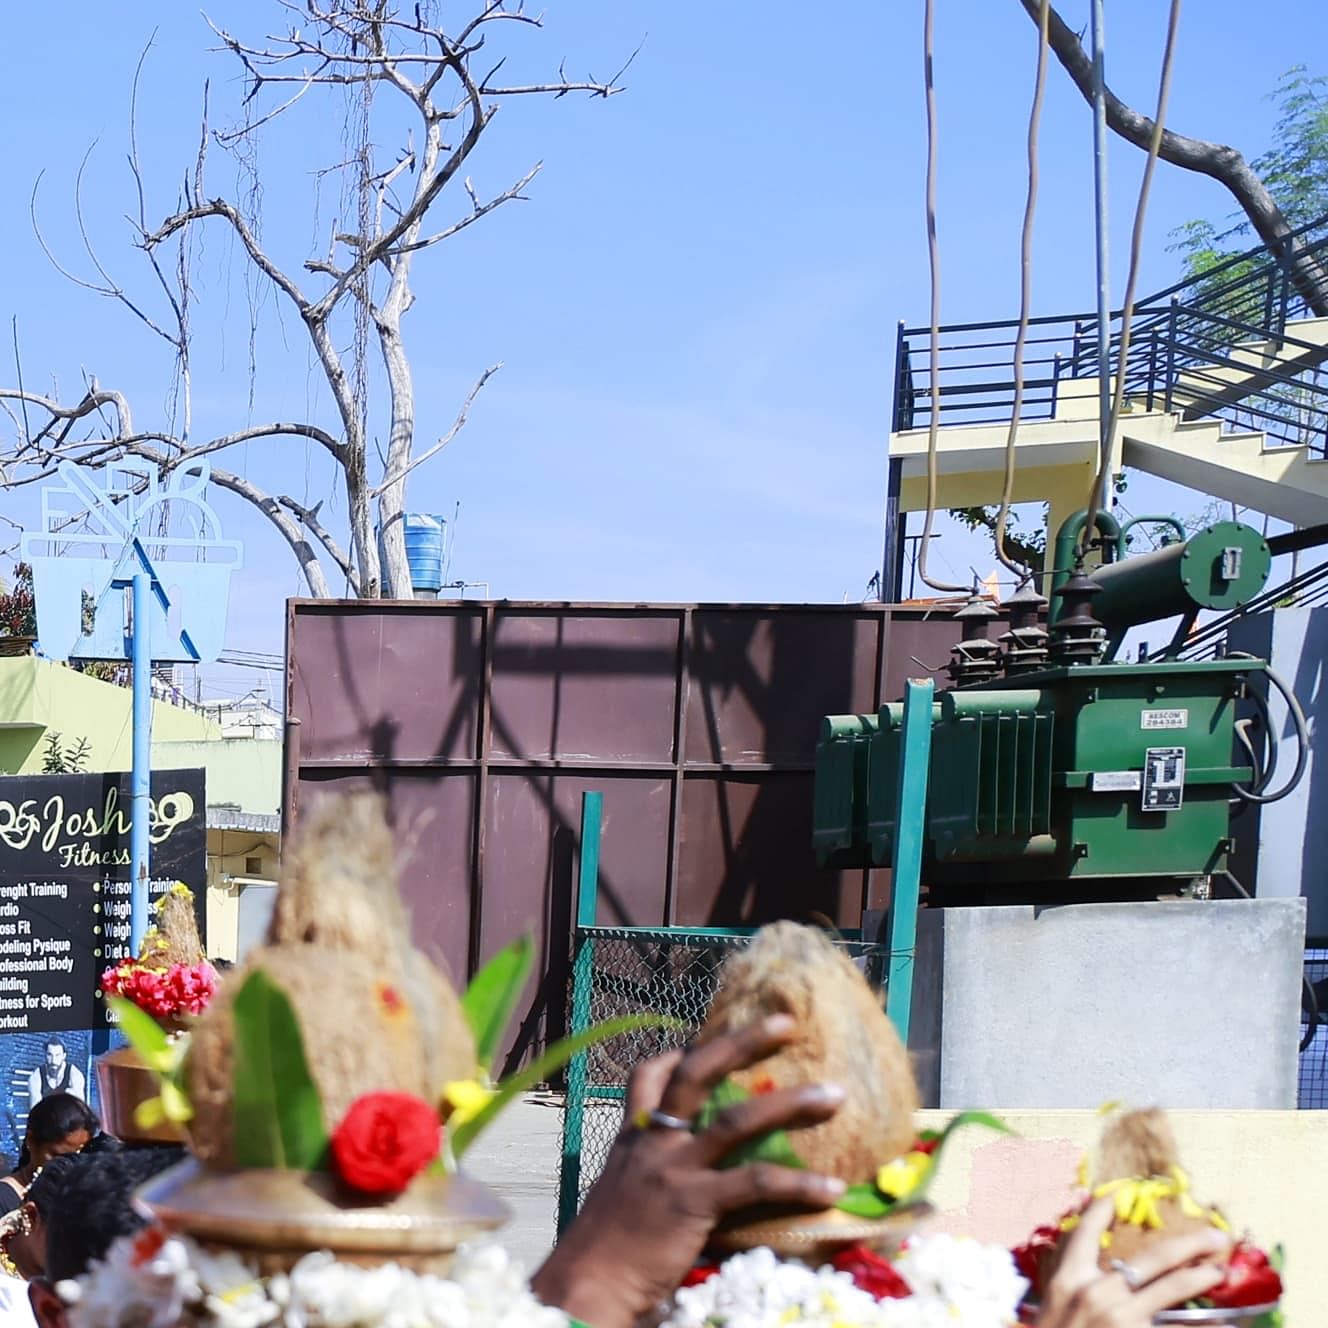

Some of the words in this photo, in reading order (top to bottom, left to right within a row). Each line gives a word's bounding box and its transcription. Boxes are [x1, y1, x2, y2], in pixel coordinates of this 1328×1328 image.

[42, 787, 132, 851] Josh
[59, 843, 131, 868] Fitness
[29, 881, 68, 899] Training
[104, 900, 132, 919] Weigh
[18, 920, 31, 935] Fit
[104, 921, 132, 941] Weigh
[33, 938, 71, 955] Pysique
[105, 943, 122, 959] Diet
[49, 956, 74, 973] Body
[25, 994, 39, 1008] for
[41, 993, 72, 1011] Sports
